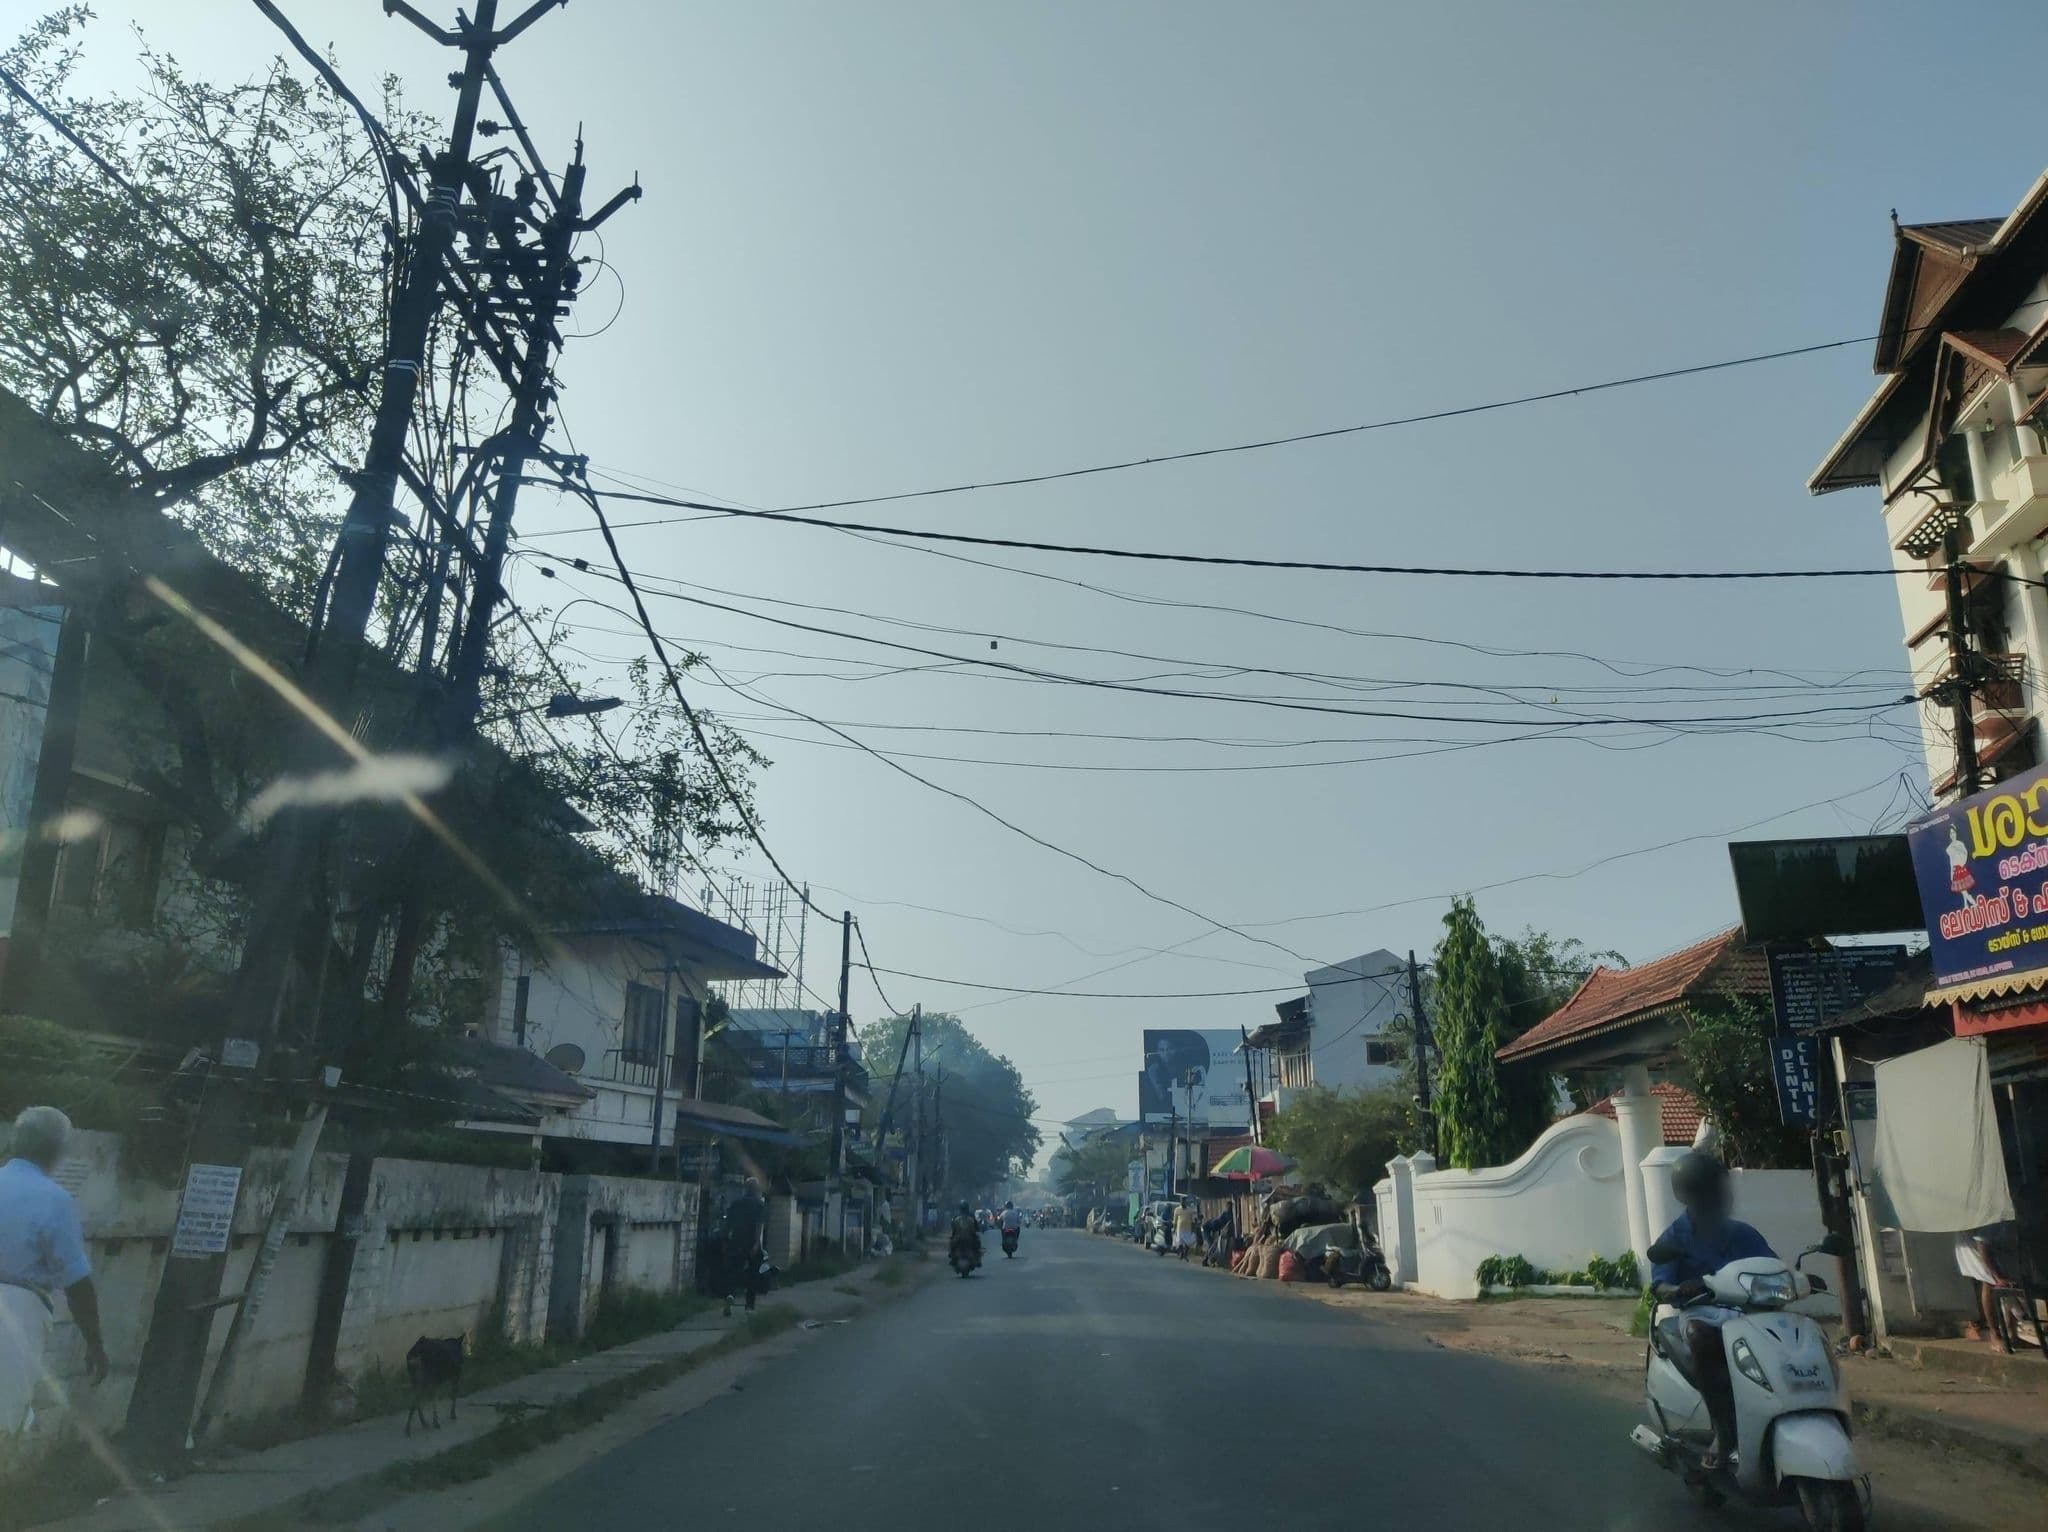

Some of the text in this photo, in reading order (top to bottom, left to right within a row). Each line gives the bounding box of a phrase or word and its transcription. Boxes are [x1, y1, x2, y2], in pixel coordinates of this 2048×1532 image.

[1940, 886, 2010, 941] ലേഡീസ്
[2013, 888, 2029, 918] &
[2022, 929, 2030, 943] &
[1782, 1049, 1802, 1113] DENTL
[1797, 1041, 1816, 1119] CLINIC
